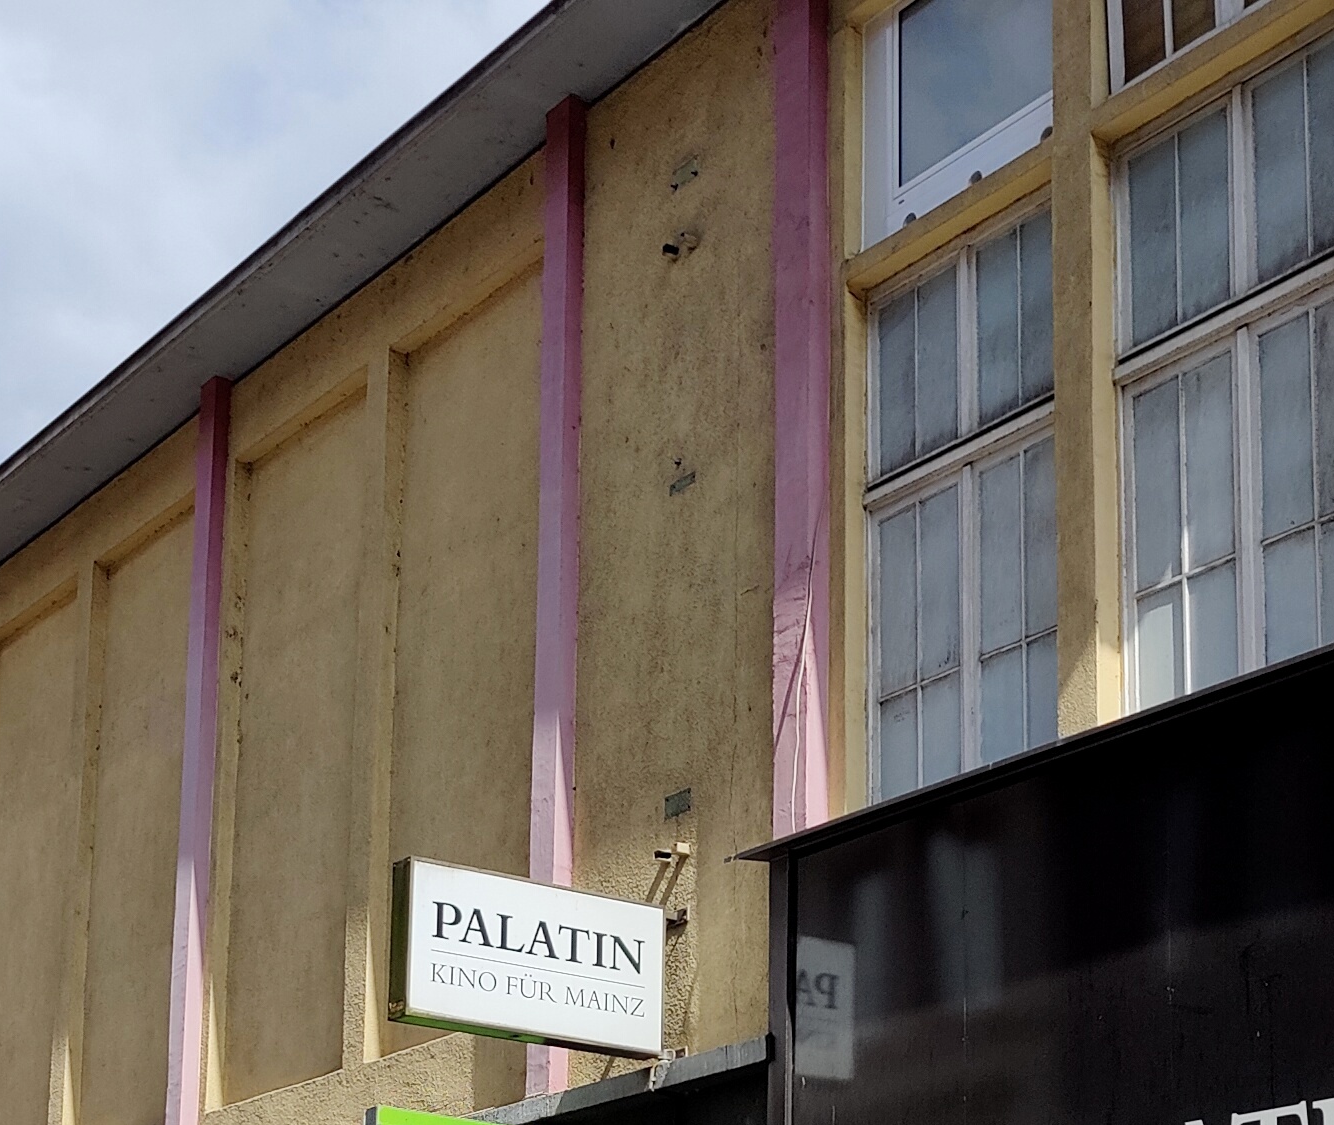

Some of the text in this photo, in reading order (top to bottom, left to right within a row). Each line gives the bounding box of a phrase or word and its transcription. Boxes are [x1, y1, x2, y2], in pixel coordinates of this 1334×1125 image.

[431, 900, 646, 975] PALATIN
[430, 962, 646, 1018] KINO FÜR MAINZ
